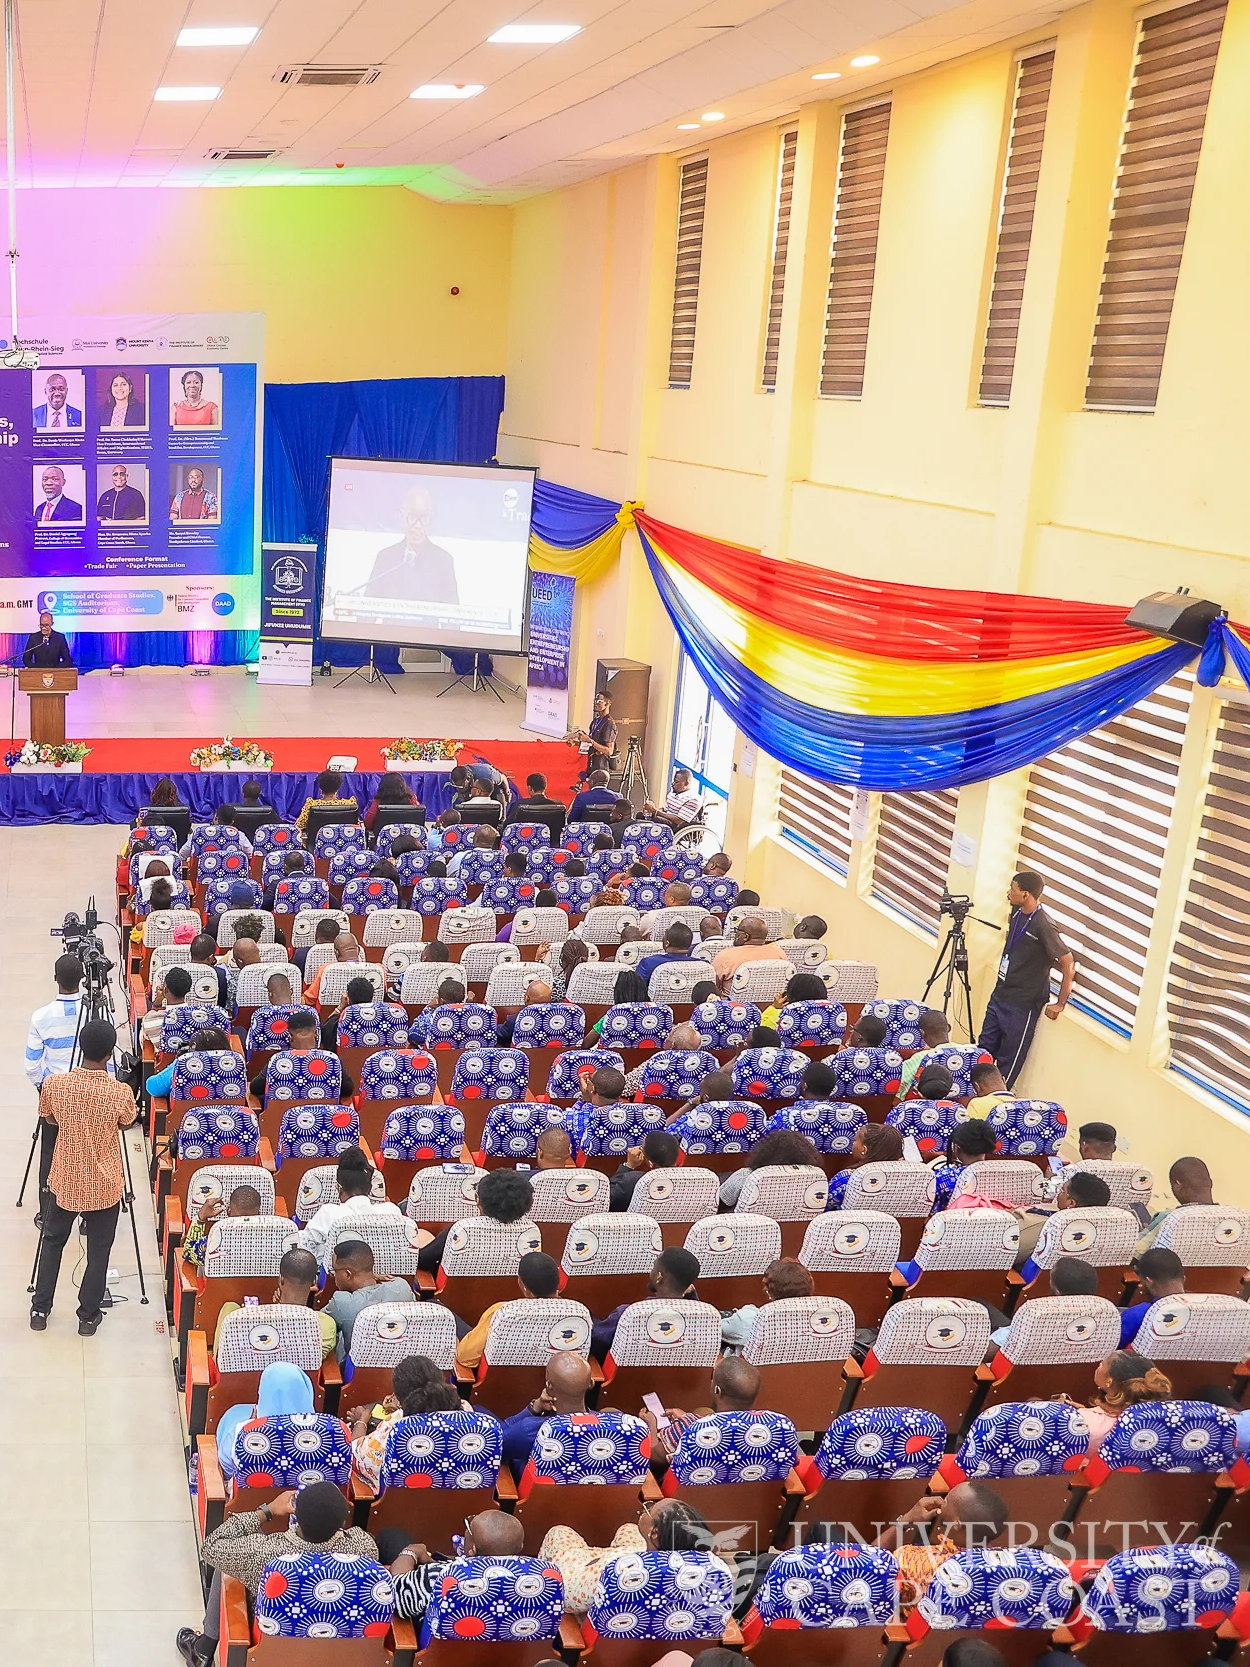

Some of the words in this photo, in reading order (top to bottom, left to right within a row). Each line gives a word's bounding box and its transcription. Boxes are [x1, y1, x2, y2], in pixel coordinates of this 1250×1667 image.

[63, 592, 86, 600] School
[96, 592, 127, 600] Graduate
[128, 592, 156, 600] Studies,
[532, 588, 553, 601] UEED
[17, 600, 33, 608] GMT
[78, 599, 119, 607] Auditorium,
[63, 606, 98, 615] University
[99, 606, 107, 614] of
[107, 606, 125, 615] Cape
[155, 1320, 165, 1334] STEP
